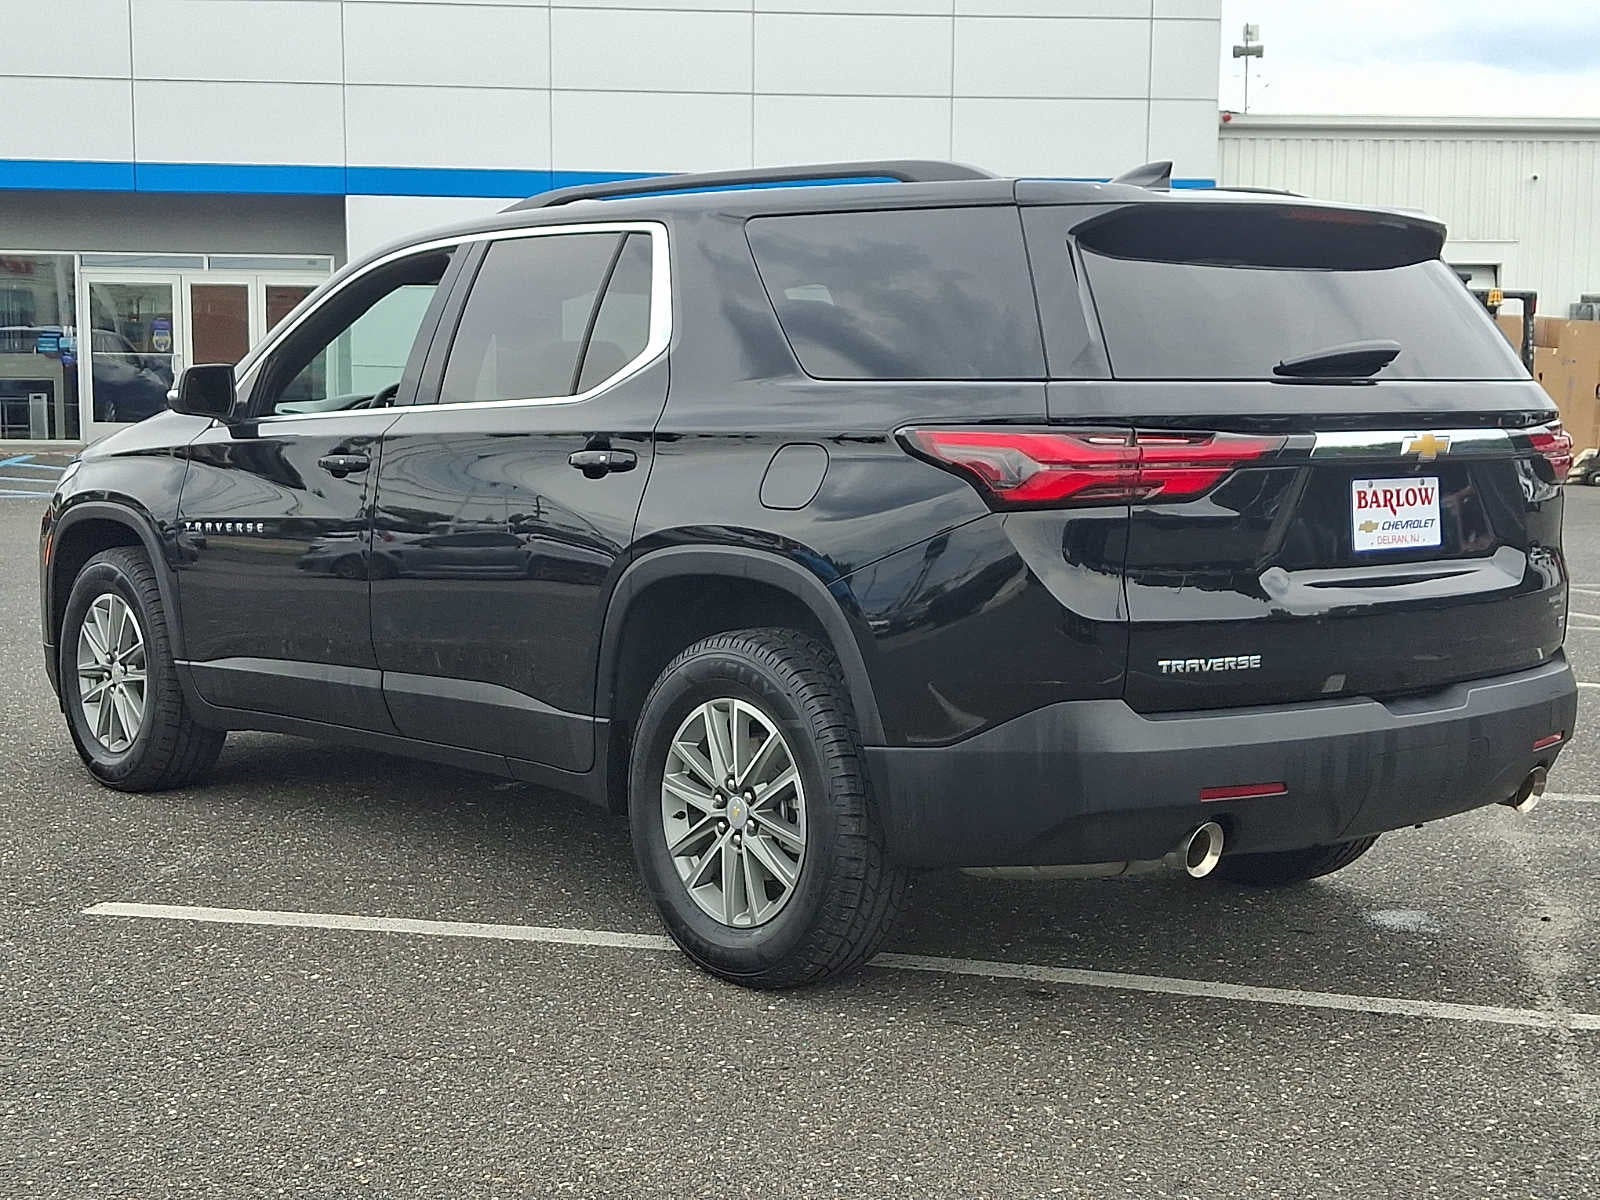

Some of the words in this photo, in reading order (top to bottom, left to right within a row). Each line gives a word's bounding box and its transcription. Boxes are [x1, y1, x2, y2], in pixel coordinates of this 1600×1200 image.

[1356, 487, 1434, 517] BARLOW
[184, 521, 264, 533] TRAVERSE
[1382, 519, 1435, 531] CHEVROLET
[1410, 533, 1420, 543] NJ
[1158, 655, 1261, 673] TRAVERSE
